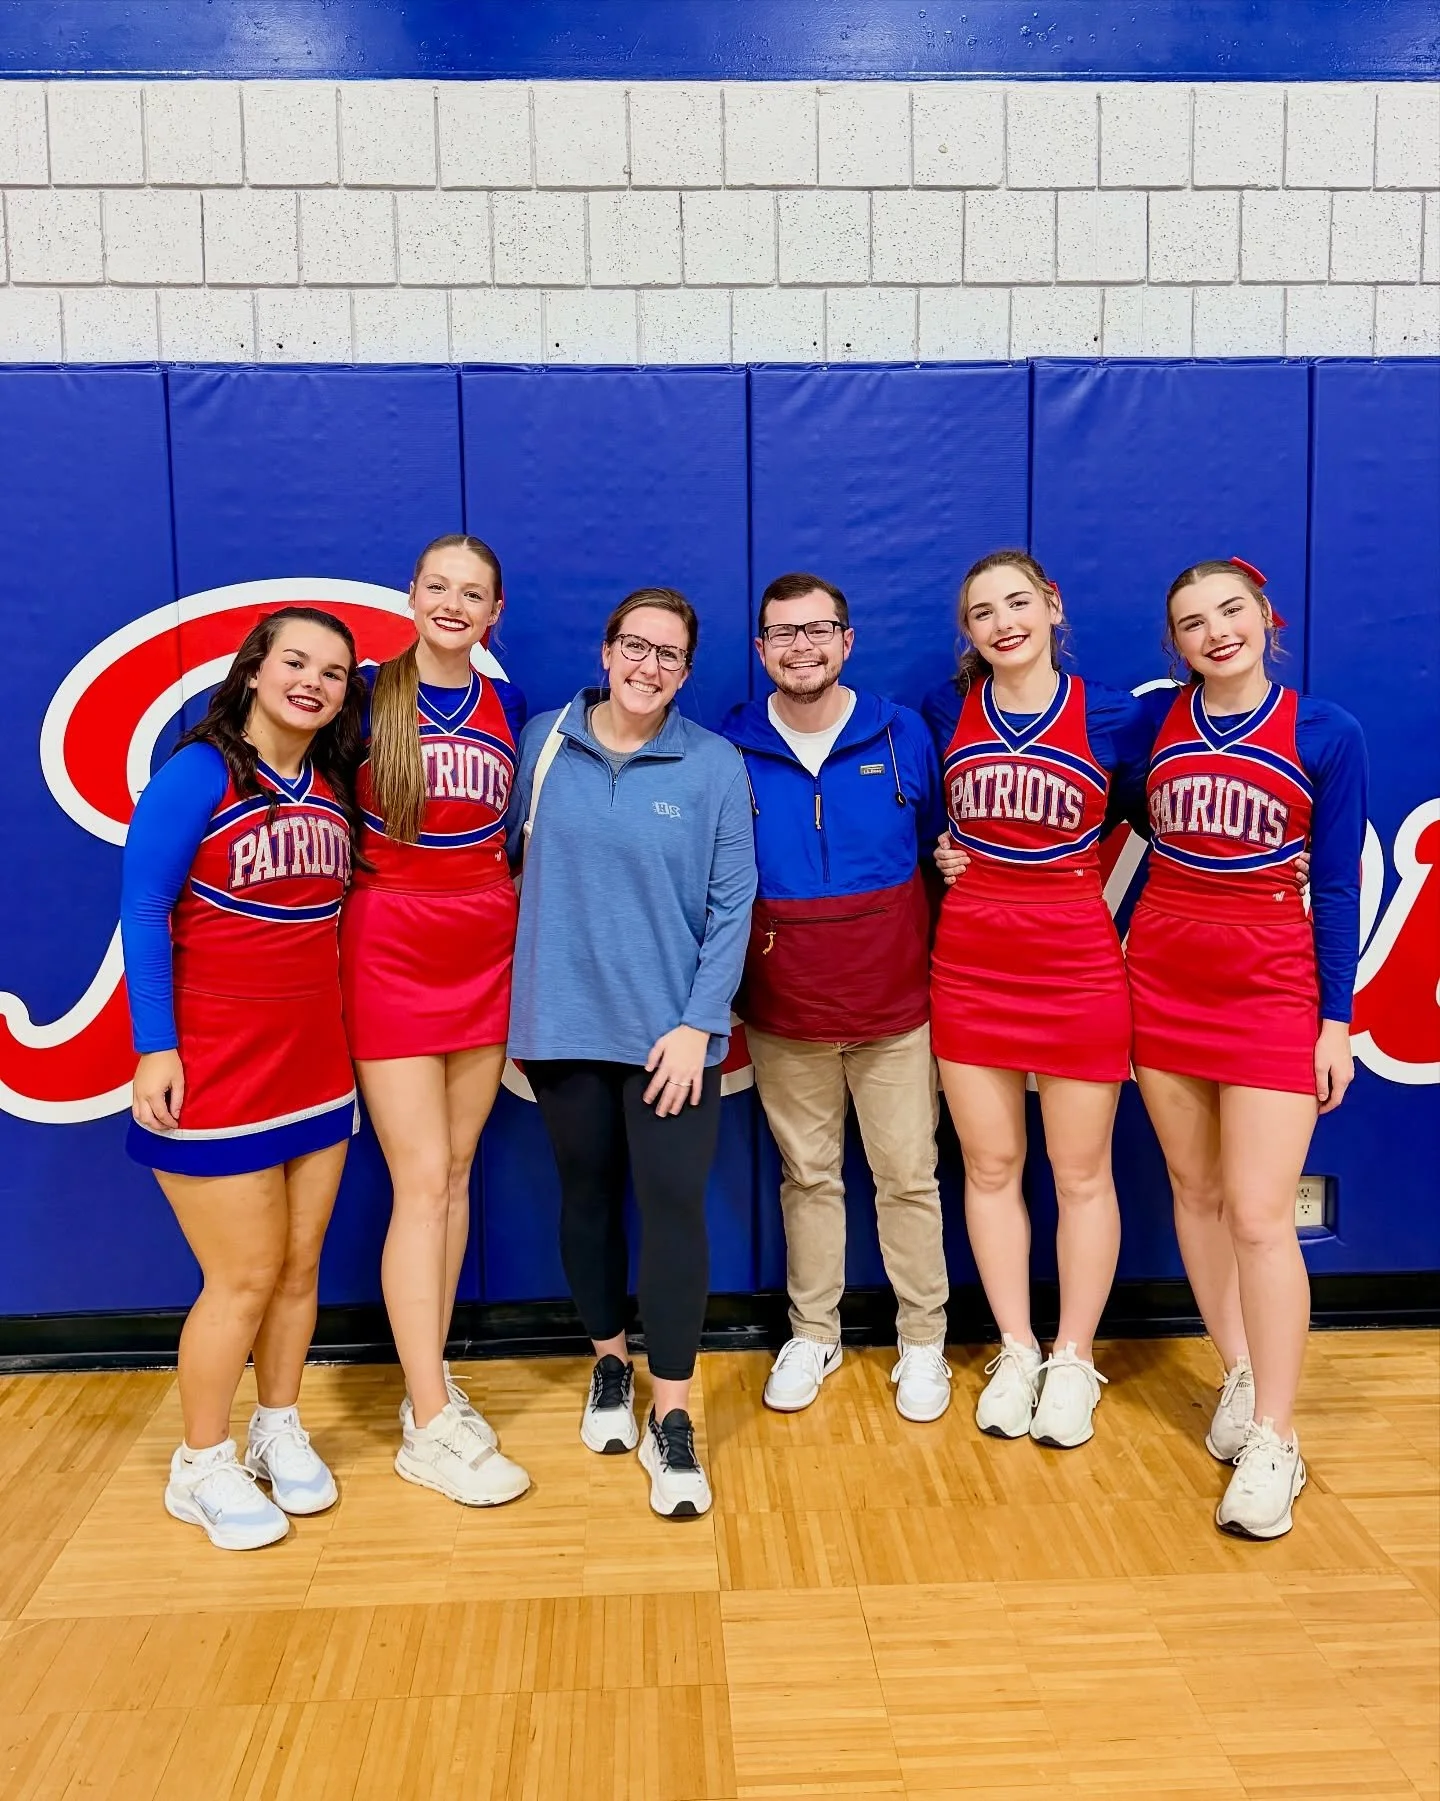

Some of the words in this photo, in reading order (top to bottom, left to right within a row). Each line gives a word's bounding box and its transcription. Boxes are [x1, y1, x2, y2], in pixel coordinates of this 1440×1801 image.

[420, 743, 510, 812] TRIOTS
[950, 764, 1083, 830] PATRIOTS
[1149, 776, 1288, 848] PATRIOTS
